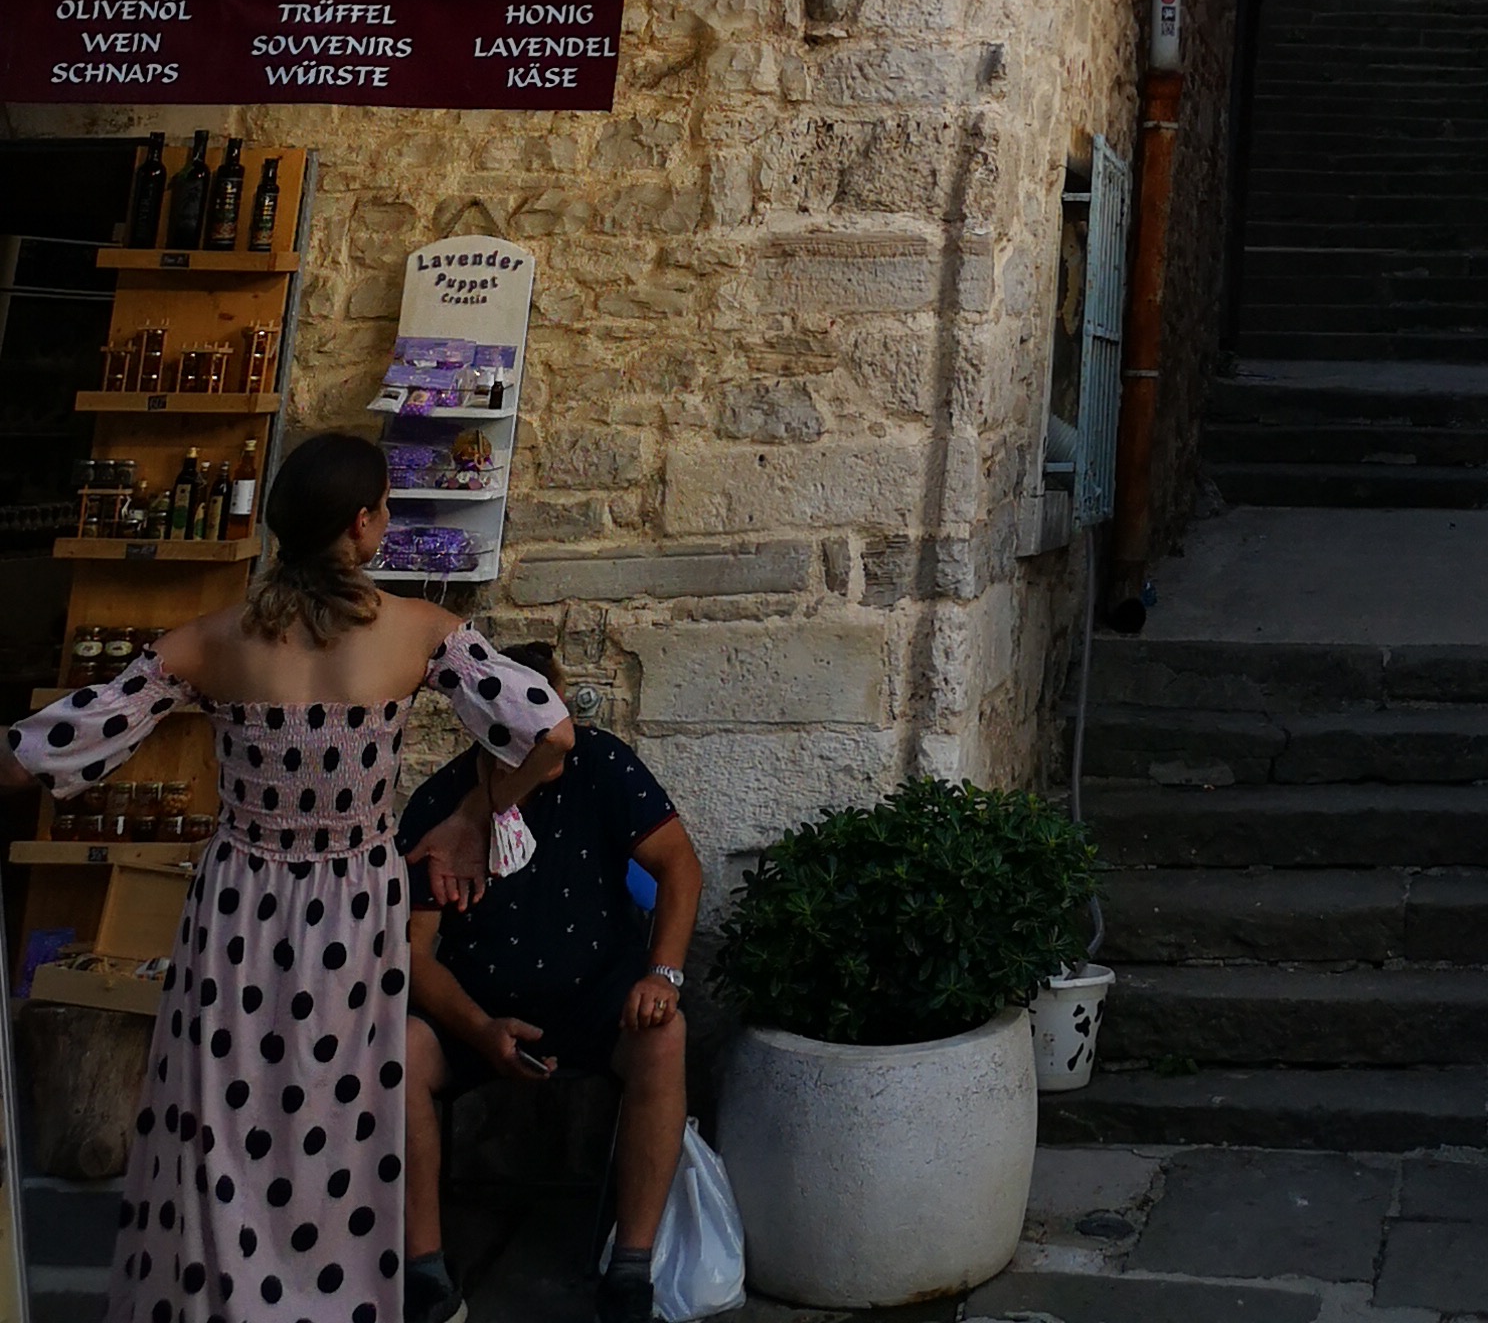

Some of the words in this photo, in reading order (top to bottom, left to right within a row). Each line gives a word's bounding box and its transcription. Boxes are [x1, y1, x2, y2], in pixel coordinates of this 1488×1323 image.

[278, 0, 397, 24] TRÜFFEL
[505, 4, 594, 24] HONIG
[81, 32, 162, 53] WEIN
[251, 35, 413, 57] SOUVENIRS
[473, 37, 616, 57] LAVENDEL
[50, 63, 179, 83] SCHNAPS
[265, 60, 390, 87] WÜRSTE
[506, 63, 578, 88] KÄSE
[417, 250, 523, 271] Lavender
[434, 272, 499, 293] Puppet
[441, 293, 488, 304] Croatia
